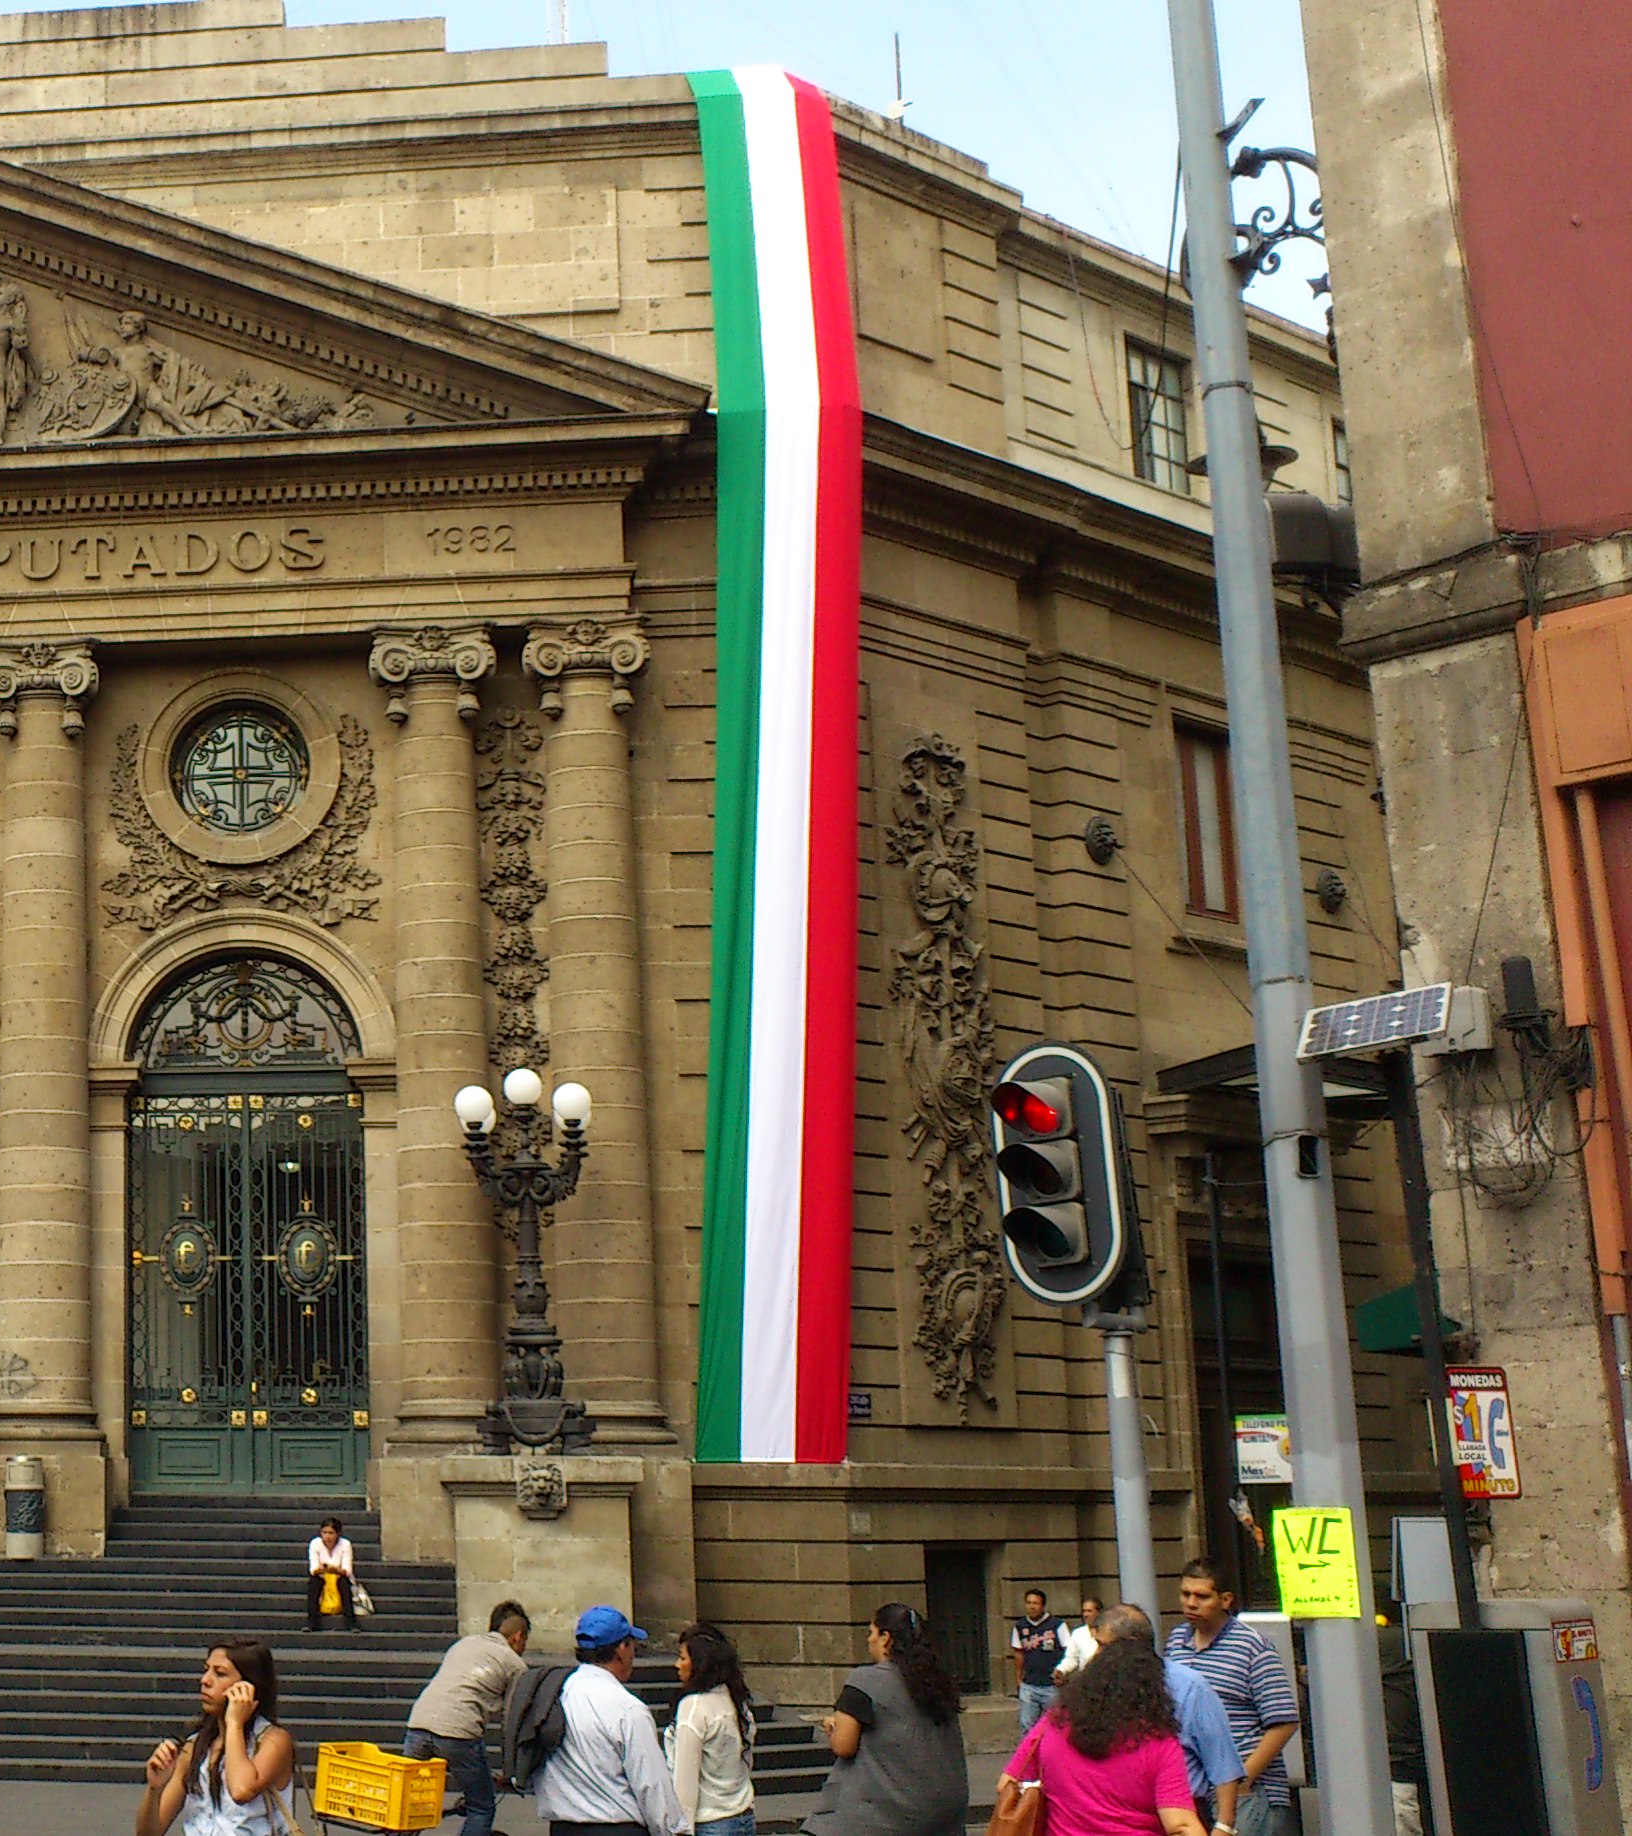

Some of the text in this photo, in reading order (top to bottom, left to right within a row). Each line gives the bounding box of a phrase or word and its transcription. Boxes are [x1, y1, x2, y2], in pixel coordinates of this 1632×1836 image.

[426, 524, 517, 557] 1982
[1449, 1374, 1504, 1388] MONEDAS
[1458, 1452, 1487, 1461] LOCAL
[1462, 1478, 1516, 1493] MINUTO
[1281, 1516, 1343, 1555] WC
